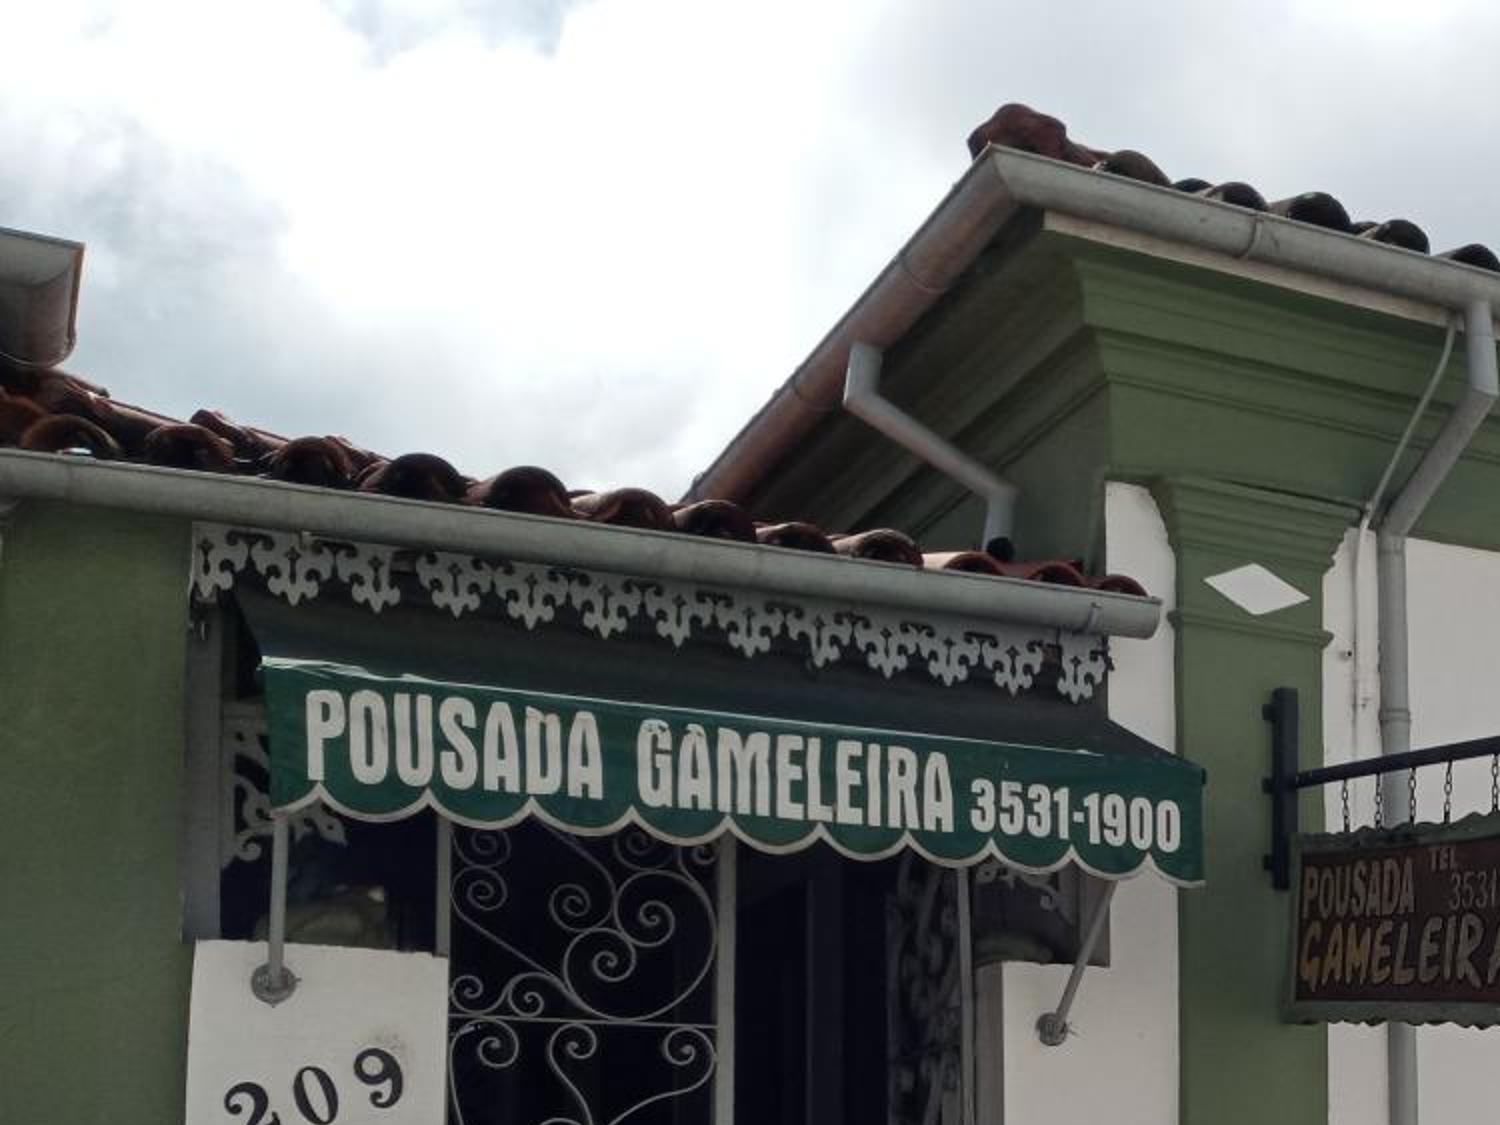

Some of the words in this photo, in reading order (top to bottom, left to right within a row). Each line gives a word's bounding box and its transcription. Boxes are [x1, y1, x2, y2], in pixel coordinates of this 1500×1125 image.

[305, 690, 602, 800] POUSADA
[637, 718, 953, 832] GAMELEIRA
[970, 777, 1181, 853] 3531-1900
[1303, 858, 1414, 918] POUSADA
